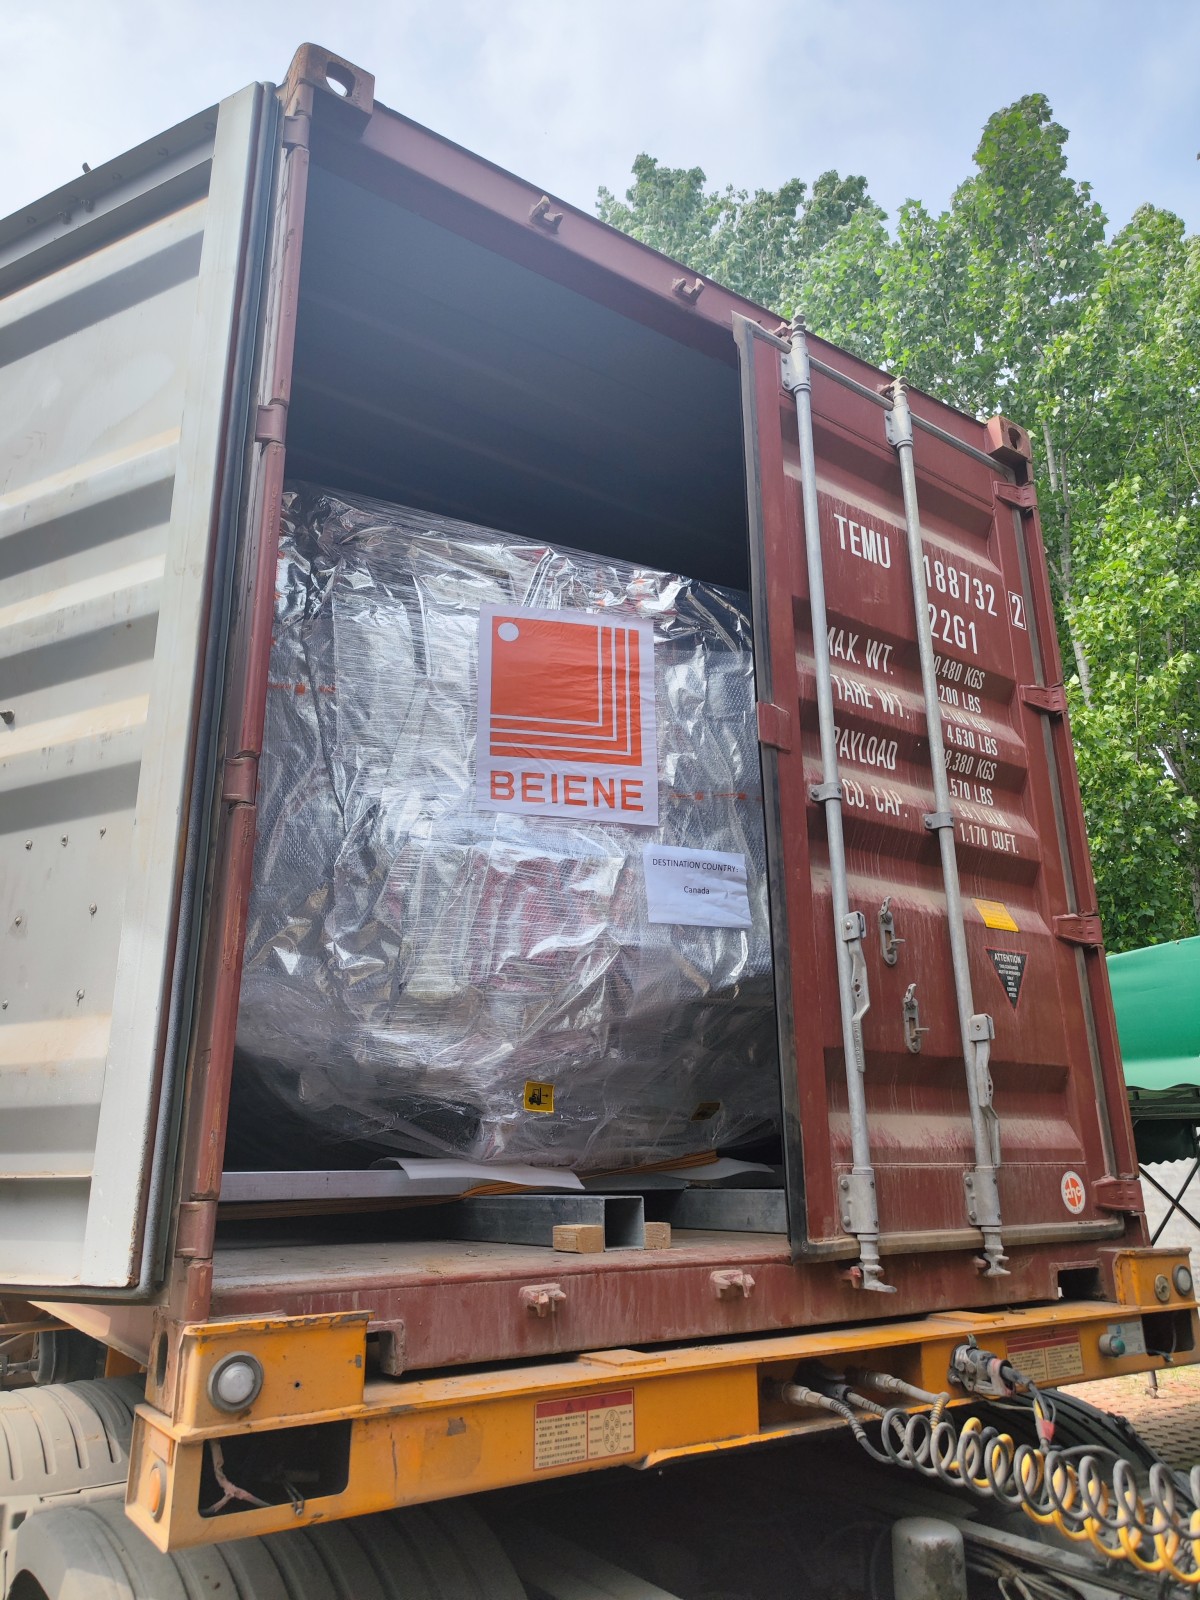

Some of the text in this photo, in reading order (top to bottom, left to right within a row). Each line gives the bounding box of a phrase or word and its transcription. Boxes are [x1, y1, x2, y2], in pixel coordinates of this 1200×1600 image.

[834, 513, 1024, 628] TEMU 188732 2
[927, 603, 978, 655] 22G1
[865, 638, 894, 676] WT.
[963, 667, 986, 690] KGS
[830, 673, 874, 709] TARE
[873, 687, 910, 719] WT.
[962, 691, 982, 717] LBS
[978, 733, 998, 756] LBS
[975, 758, 998, 781] KGS
[490, 770, 644, 812] BEIENE
[842, 778, 869, 810] CU.
[871, 785, 908, 818] CAP.
[974, 784, 994, 806] LBS
[652, 858, 701, 869] DESTINATION
[683, 885, 710, 895] Canada
[994, 953, 1022, 964] ATTENTION
